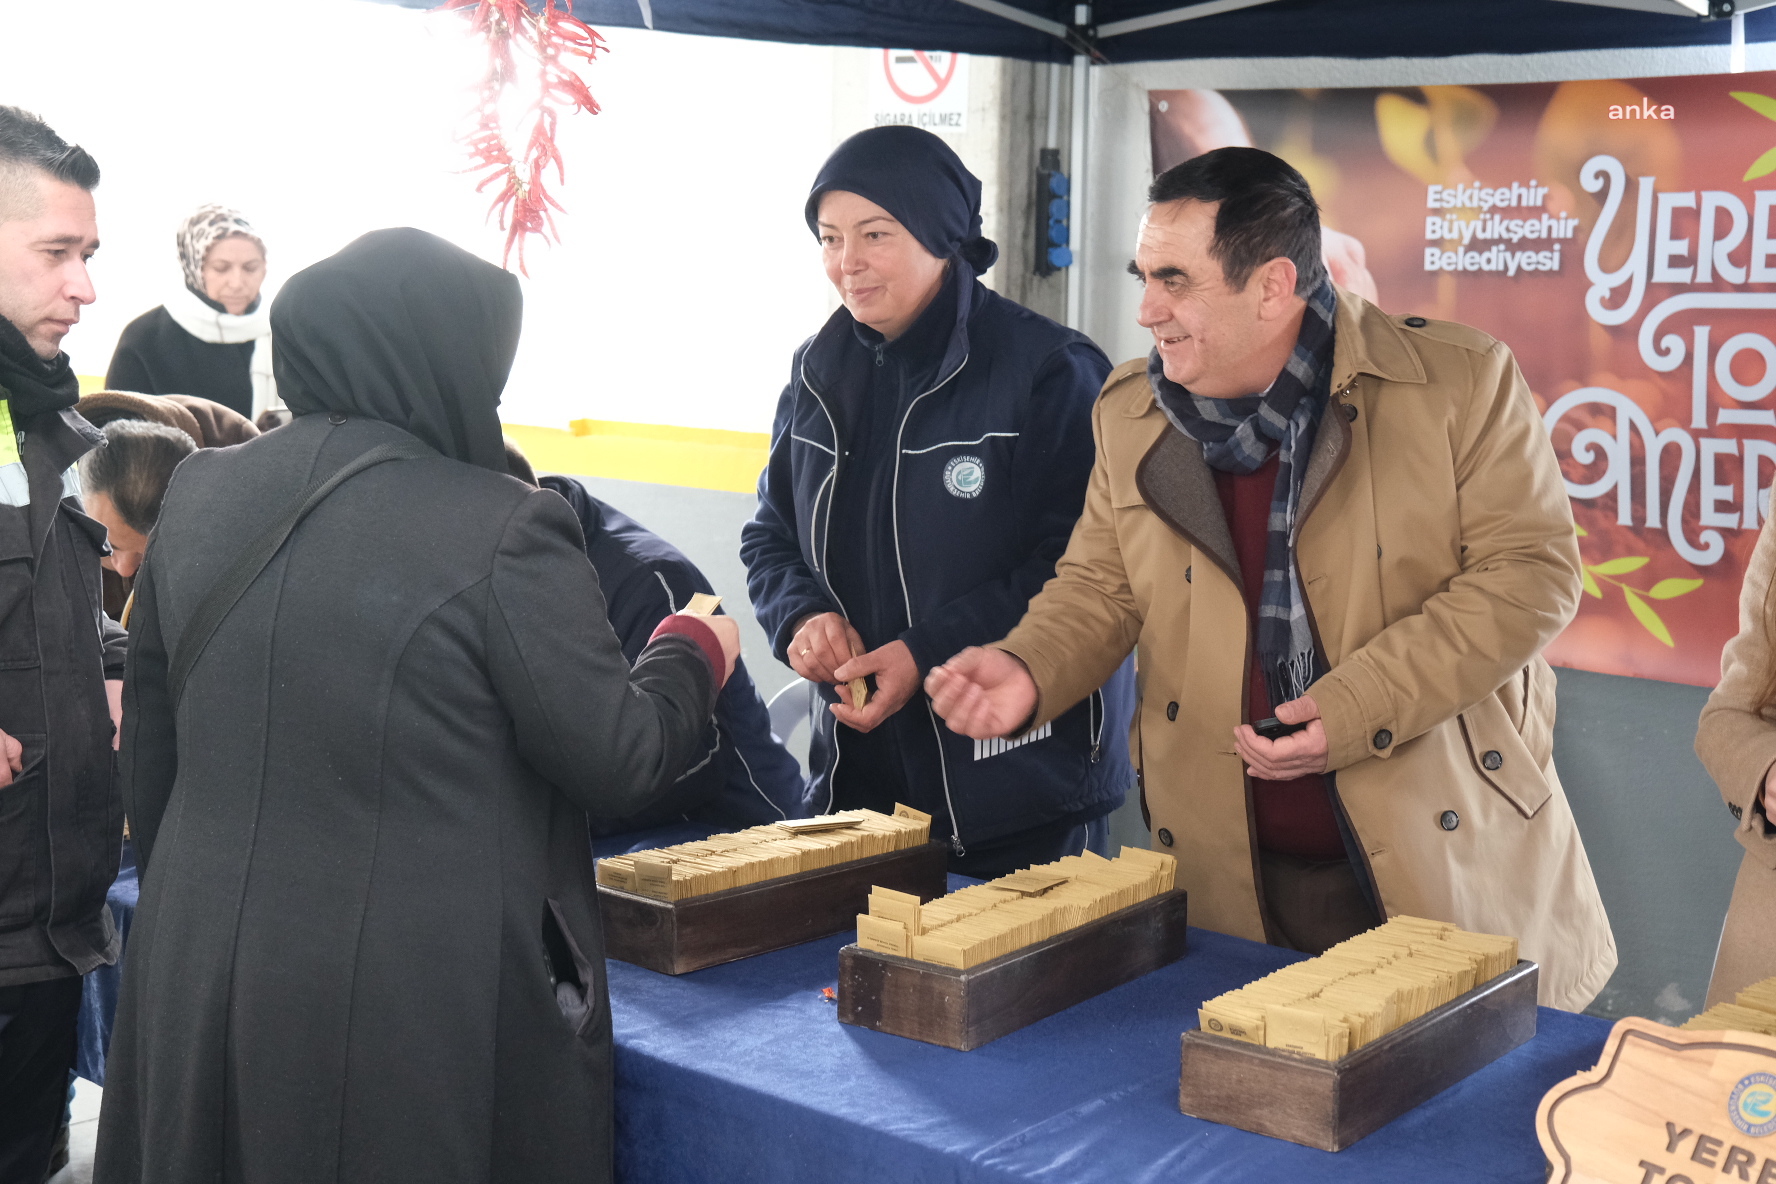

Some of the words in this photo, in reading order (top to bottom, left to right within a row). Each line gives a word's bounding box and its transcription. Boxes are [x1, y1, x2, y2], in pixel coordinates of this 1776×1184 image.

[1426, 179, 1549, 211] Eskişehir
[1425, 211, 1579, 245] Büyükşehir
[1424, 243, 1561, 276] Belediyesi
